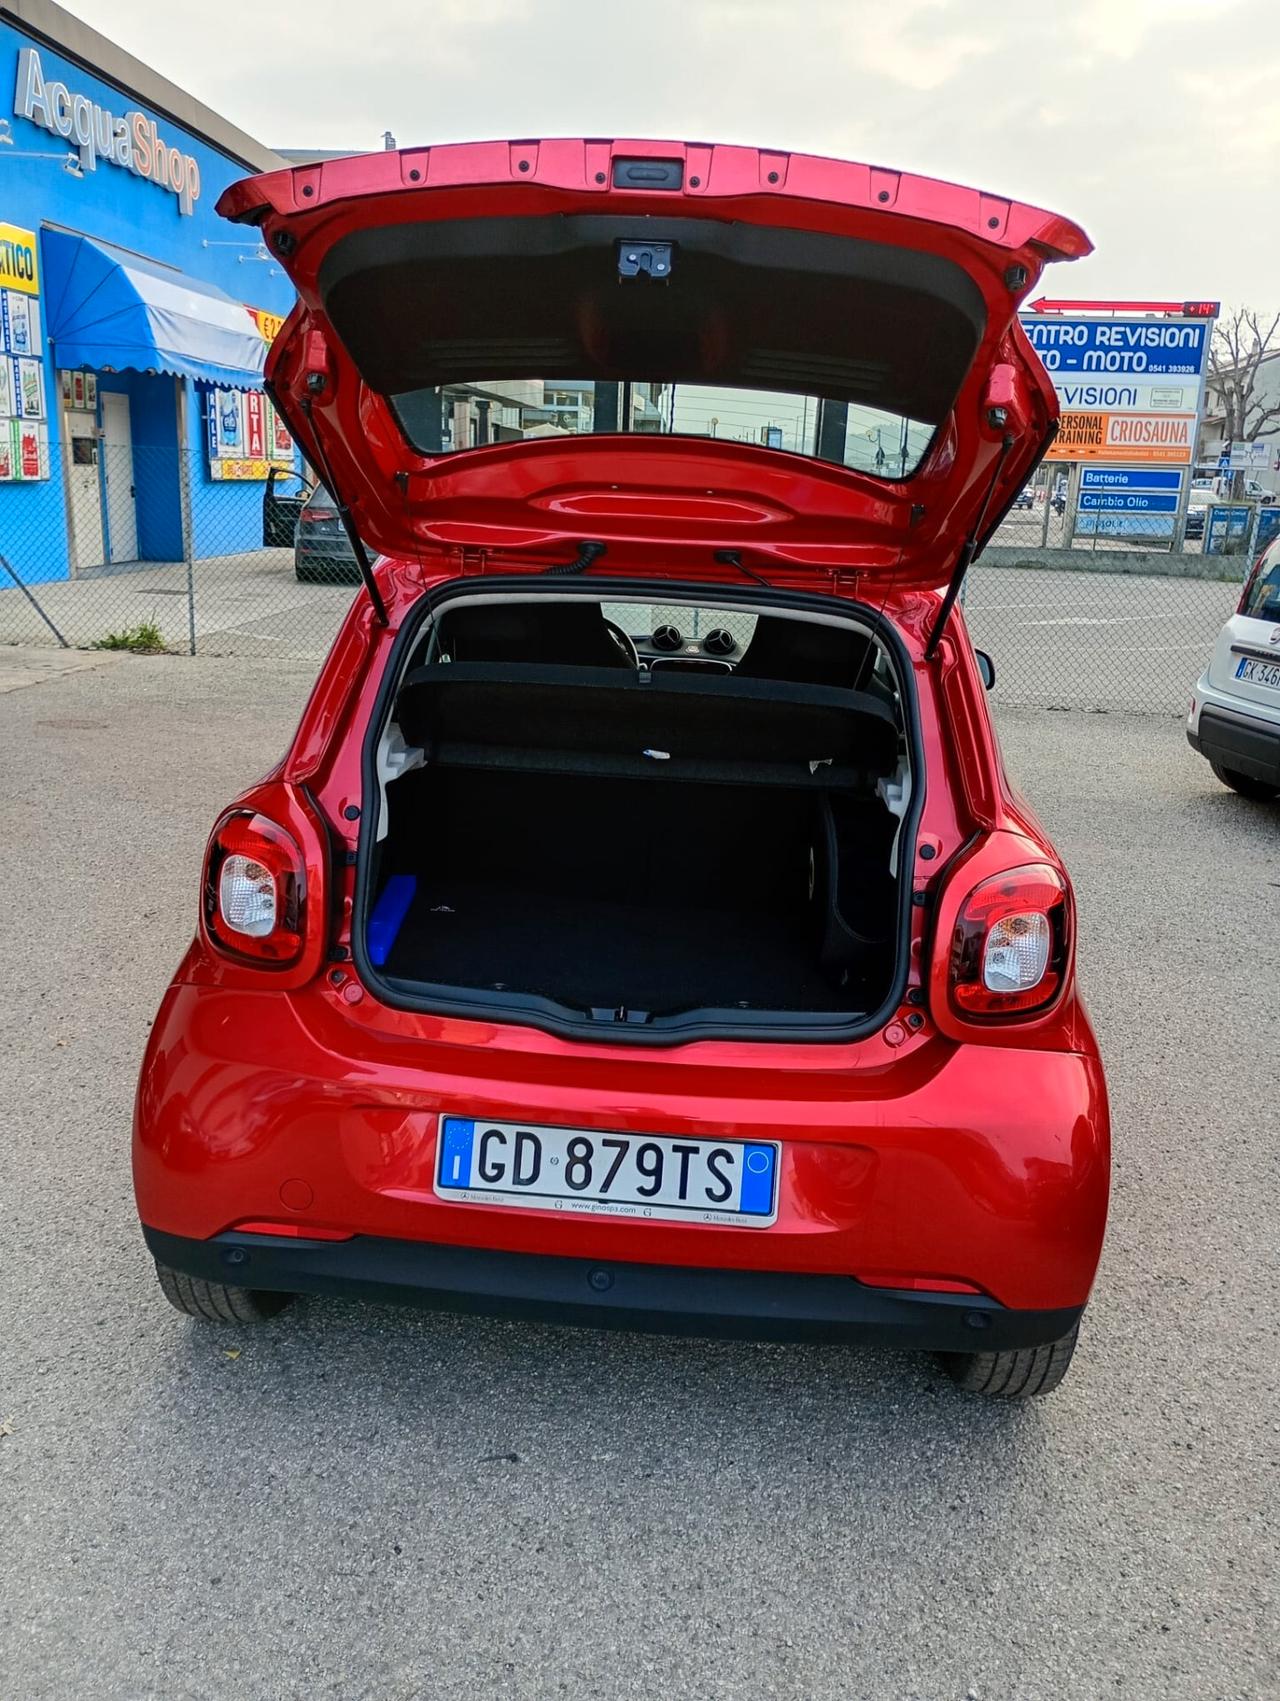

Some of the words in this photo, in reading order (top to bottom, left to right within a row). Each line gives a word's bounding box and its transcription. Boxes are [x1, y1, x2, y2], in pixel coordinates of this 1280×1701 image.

[14, 48, 200, 216] AcquaShop
[1095, 326, 1200, 348] REVISIONI
[1083, 351, 1147, 372] MOTO
[1148, 364, 1166, 372] 0541
[1055, 387, 1138, 406] VISIONI
[1111, 420, 1188, 443] CRIOSAUNA
[1086, 473, 1129, 484] Batterie
[1083, 496, 1124, 507] Cambio
[1127, 497, 1149, 507] Olio
[478, 1129, 542, 1186] GD
[565, 1136, 735, 1203] 879TS
